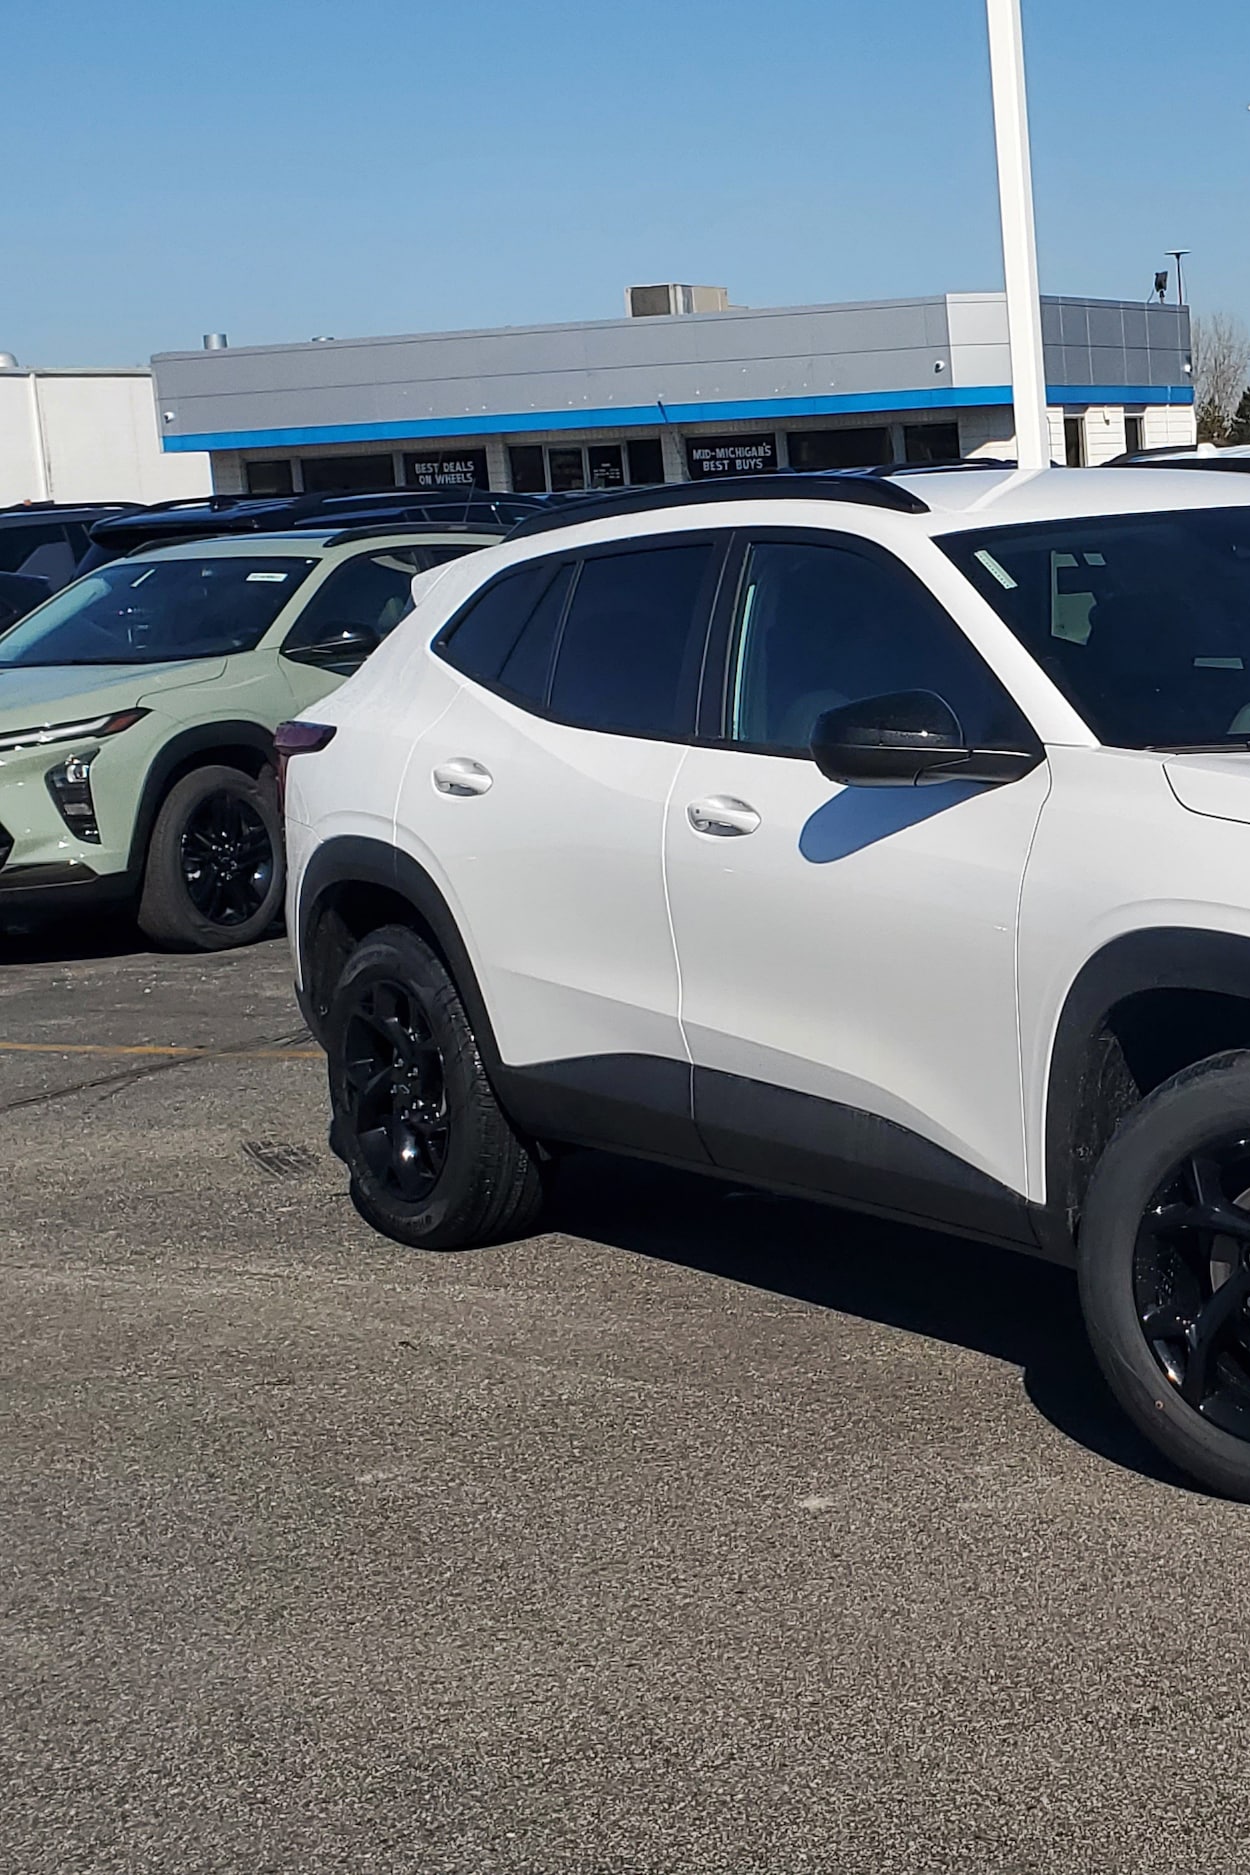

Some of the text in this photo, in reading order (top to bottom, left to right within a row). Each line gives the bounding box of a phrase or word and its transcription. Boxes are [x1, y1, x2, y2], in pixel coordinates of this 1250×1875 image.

[692, 442, 772, 460] MID-MICHIGAN'S
[415, 461, 474, 474] BEST DEALS
[702, 459, 763, 471] BEST BUYS
[419, 473, 473, 485] ON WHEELS
